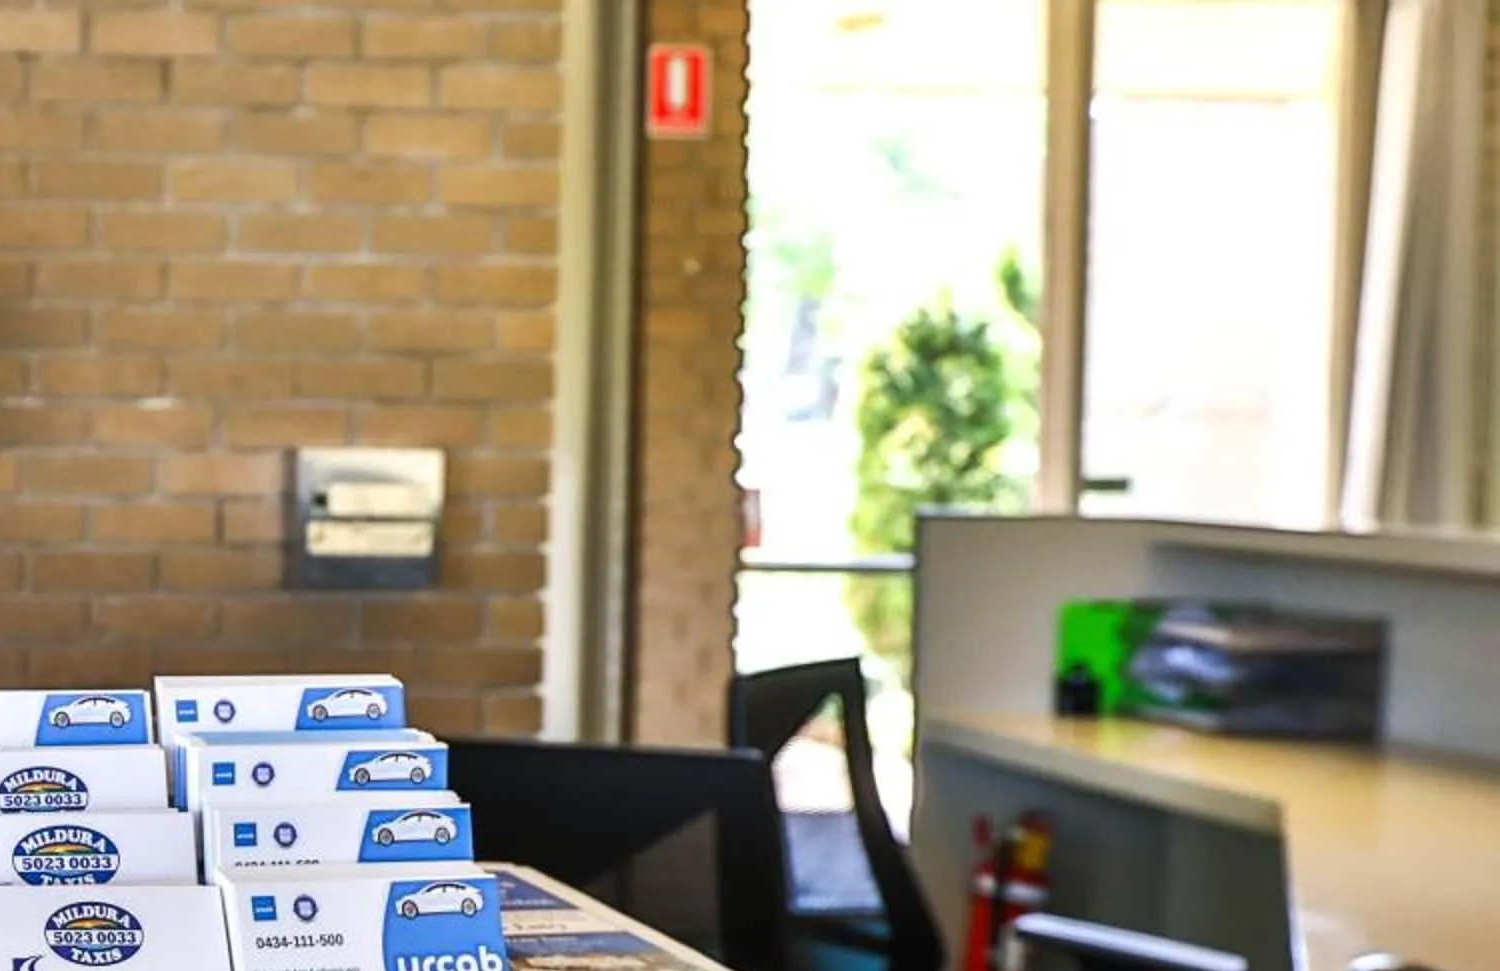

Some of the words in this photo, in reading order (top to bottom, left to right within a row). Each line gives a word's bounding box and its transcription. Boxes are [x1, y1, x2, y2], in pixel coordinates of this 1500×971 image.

[4, 769, 78, 792] MILDURA
[3, 794, 41, 808] 5023
[45, 793, 83, 807] 0033
[22, 828, 106, 855] MILDURA
[21, 857, 65, 872] 5023
[69, 857, 113, 870] 0033
[53, 904, 132, 929] MILDURA
[53, 931, 94, 945] 5023
[96, 931, 137, 945] 0033
[255, 933, 344, 949] 0434-111-500
[69, 948, 123, 964] TAXIS
